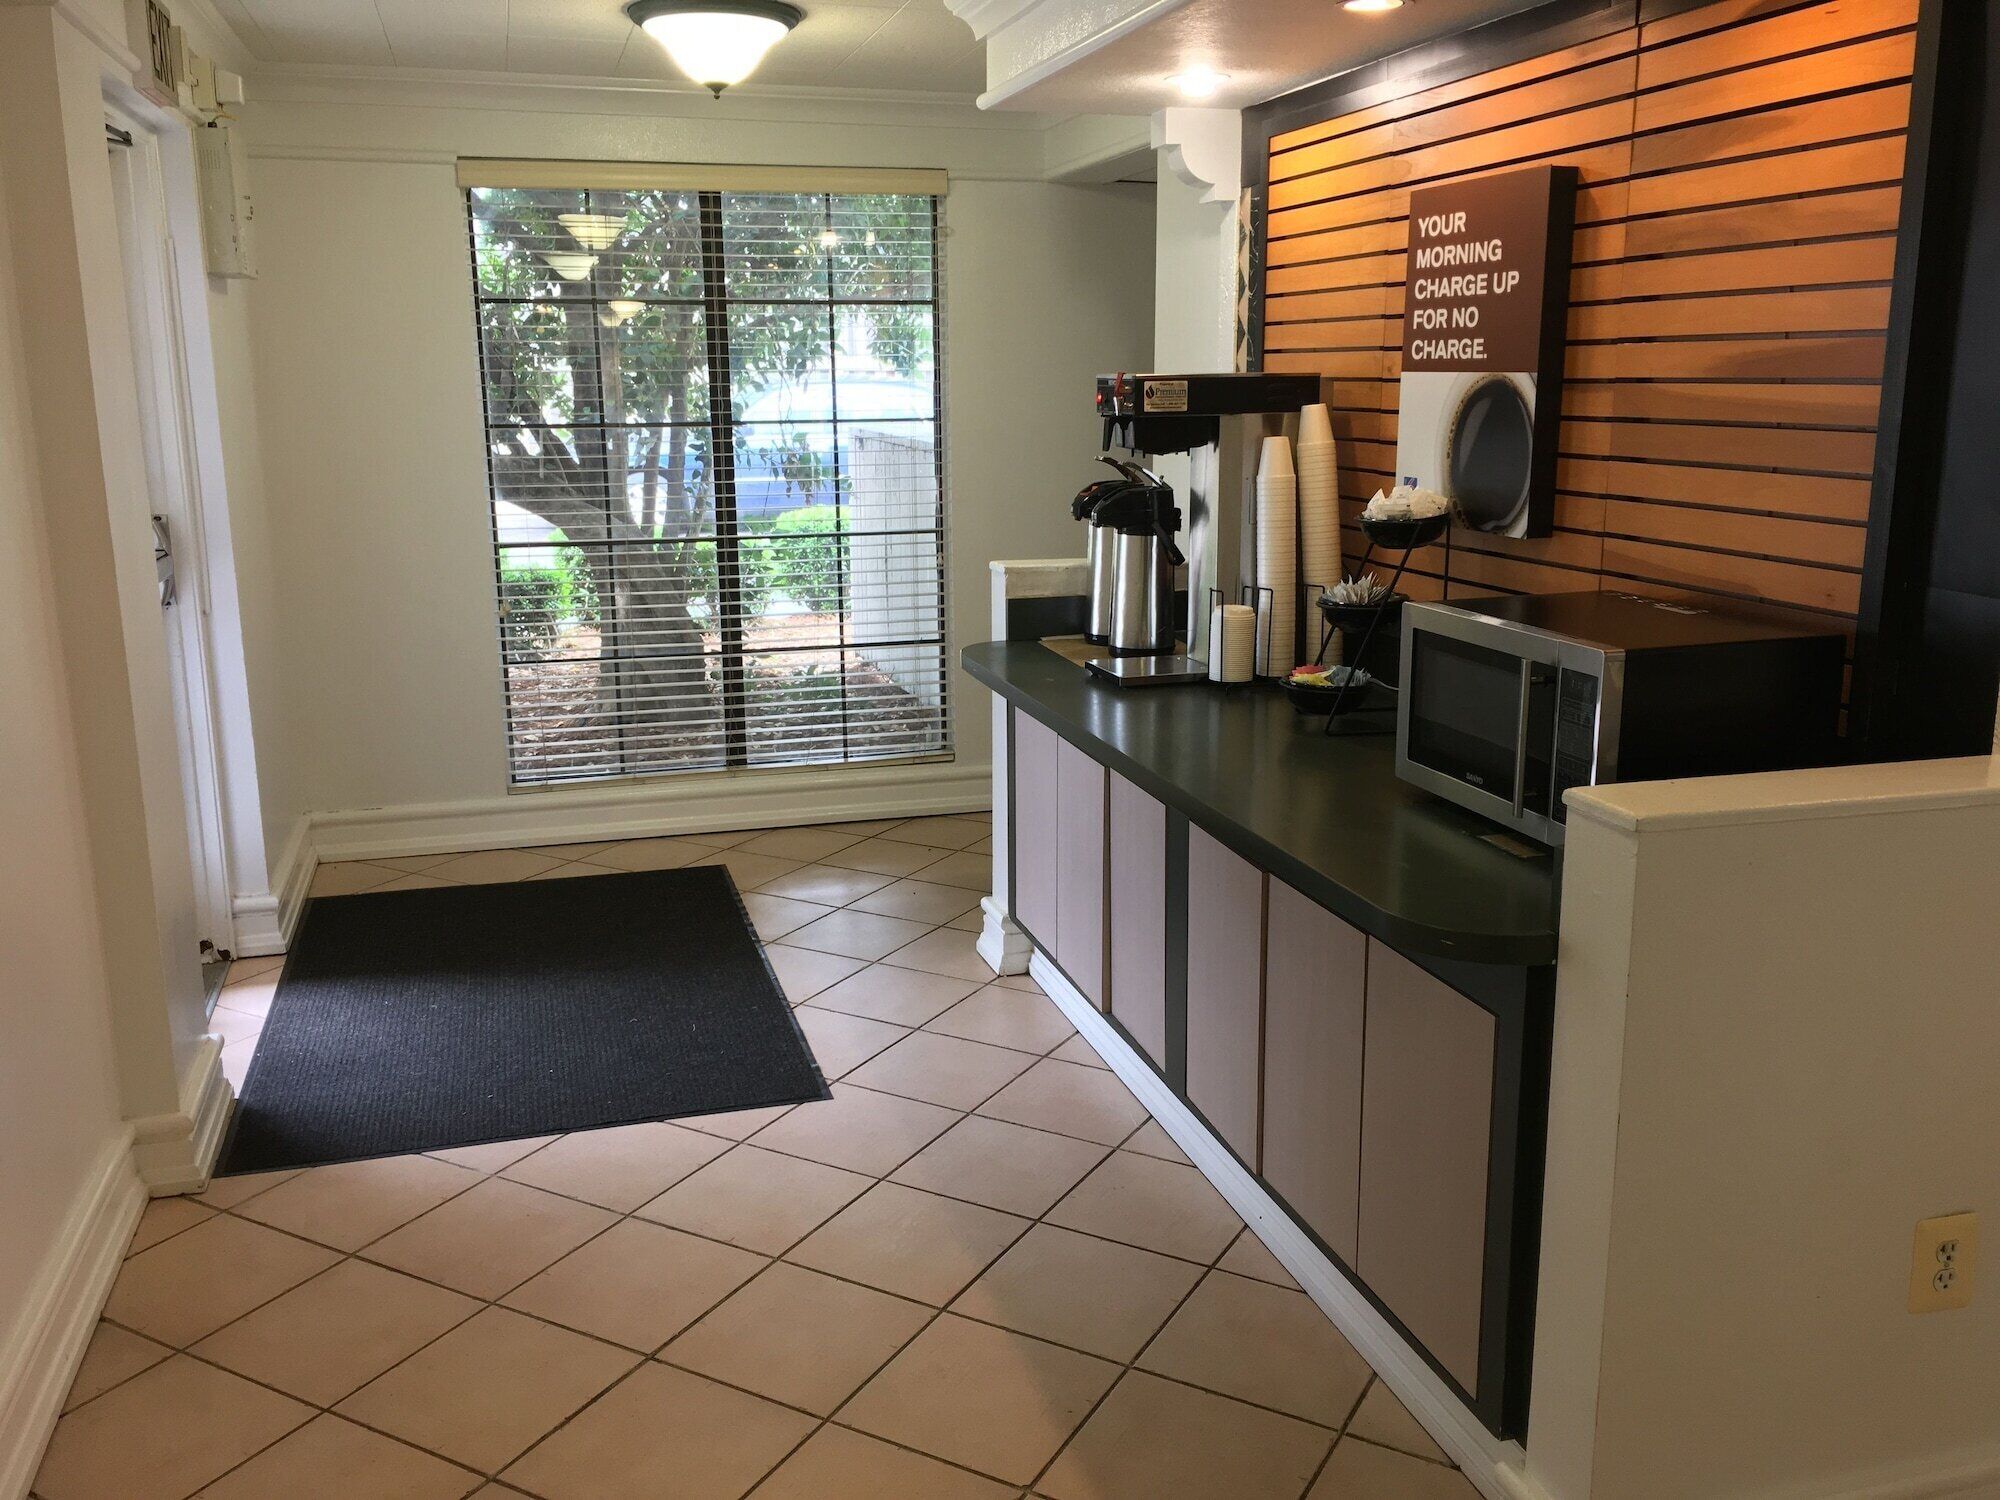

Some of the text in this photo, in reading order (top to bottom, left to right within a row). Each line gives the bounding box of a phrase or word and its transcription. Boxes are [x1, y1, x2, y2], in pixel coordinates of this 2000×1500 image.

[1418, 212, 1467, 237] YOUR
[1416, 239, 1503, 269] MORNING
[1415, 271, 1520, 300] CHARGE UP
[1413, 306, 1479, 329] FOR NO
[1412, 338, 1488, 360] CHARGE.
